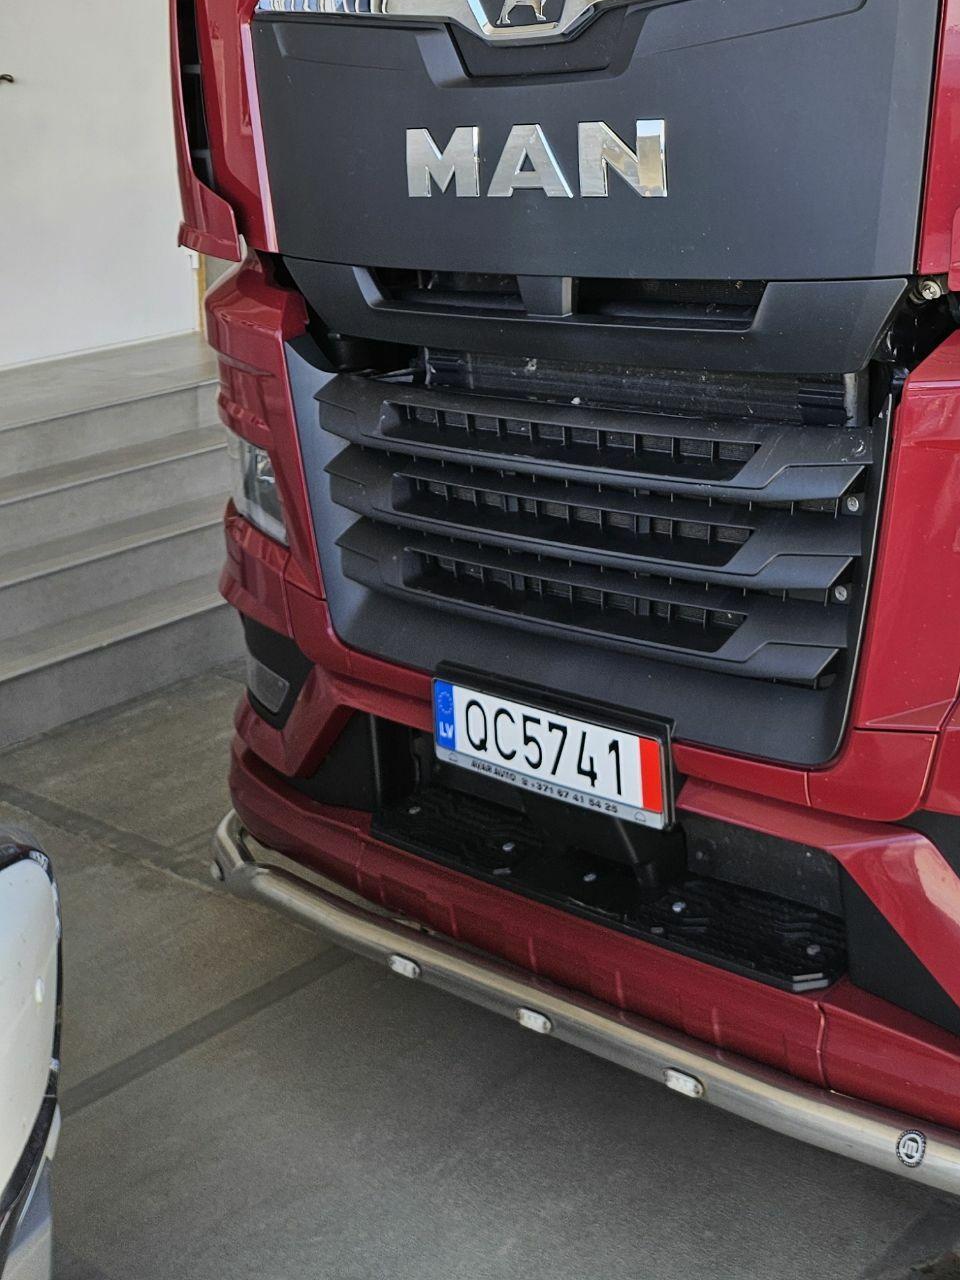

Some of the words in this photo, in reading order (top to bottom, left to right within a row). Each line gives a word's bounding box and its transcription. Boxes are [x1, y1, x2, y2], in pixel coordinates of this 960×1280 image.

[406, 119, 668, 198] MAN
[439, 720, 454, 739] LV
[465, 699, 622, 796] QC5741
